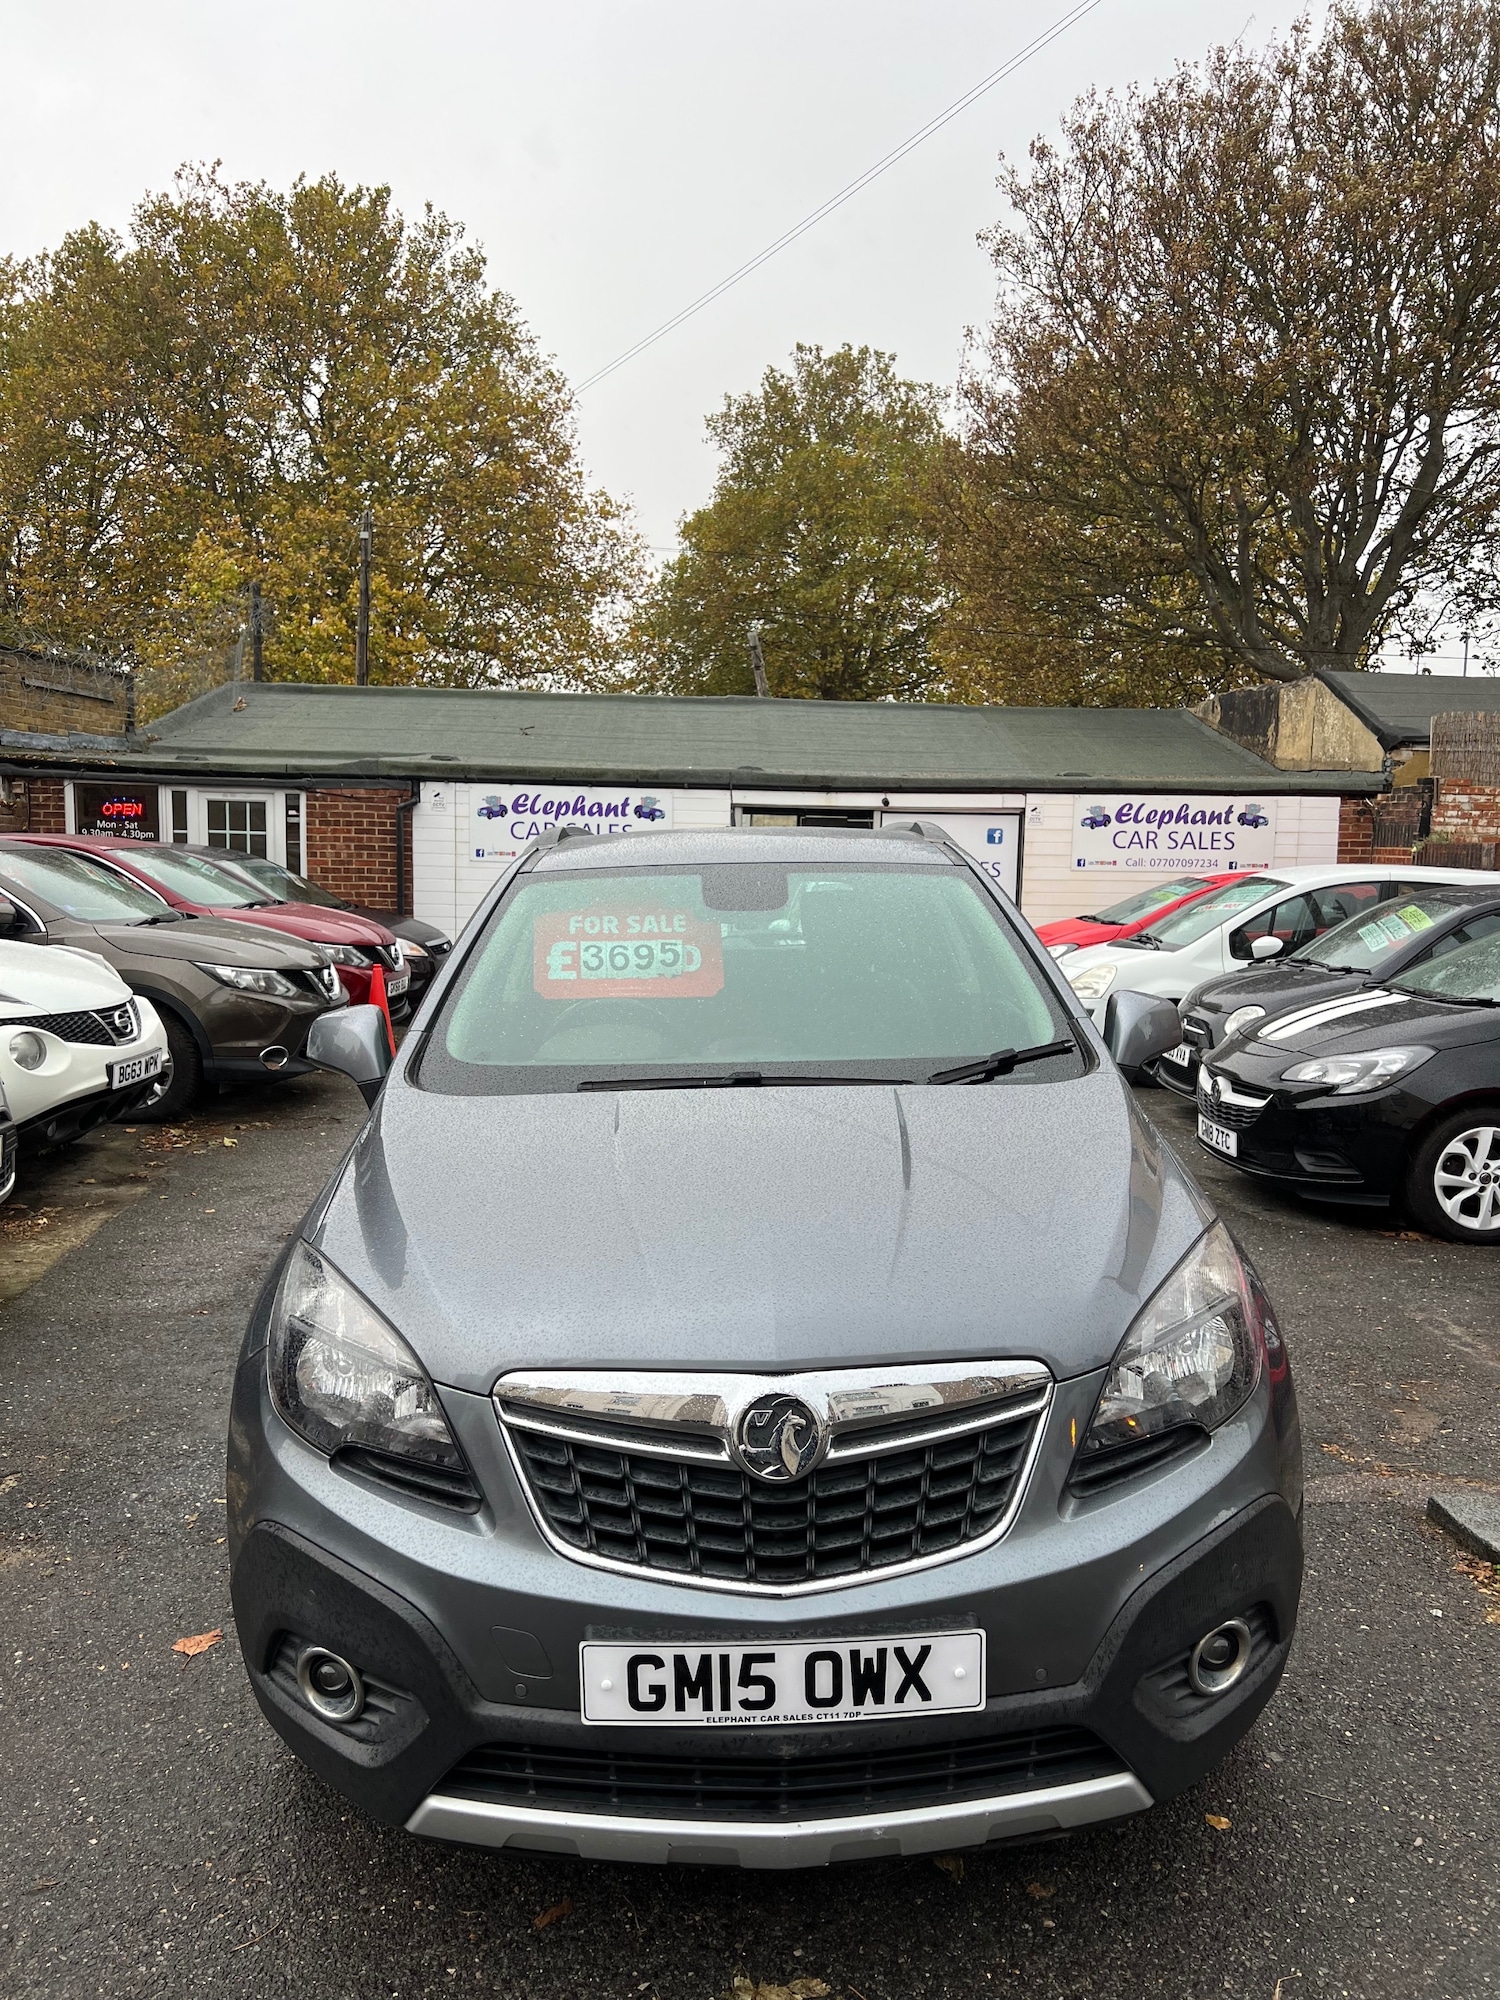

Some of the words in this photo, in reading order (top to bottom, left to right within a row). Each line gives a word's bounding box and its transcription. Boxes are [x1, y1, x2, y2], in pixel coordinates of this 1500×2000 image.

[102, 803, 143, 816] OPEN
[511, 793, 630, 820] Elephant
[1114, 802, 1234, 829] Elephant
[96, 820, 117, 829] Mon
[124, 821, 139, 829] Sat
[121, 830, 155, 839] 4.30pm
[1112, 830, 1159, 850] CAR
[1167, 831, 1236, 850] SALES
[1125, 858, 1147, 868] Call:
[1149, 858, 1219, 868] 07707097234
[569, 915, 619, 934] FOR
[627, 914, 687, 934] SALE
[118, 1060, 142, 1084] BG63
[1215, 1127, 1231, 1150] ZTC
[626, 1653, 777, 1712] GM15
[804, 1645, 932, 1708] OWX
[706, 1715, 757, 1723] ELEPHANT
[843, 1711, 862, 1719] 7DP
